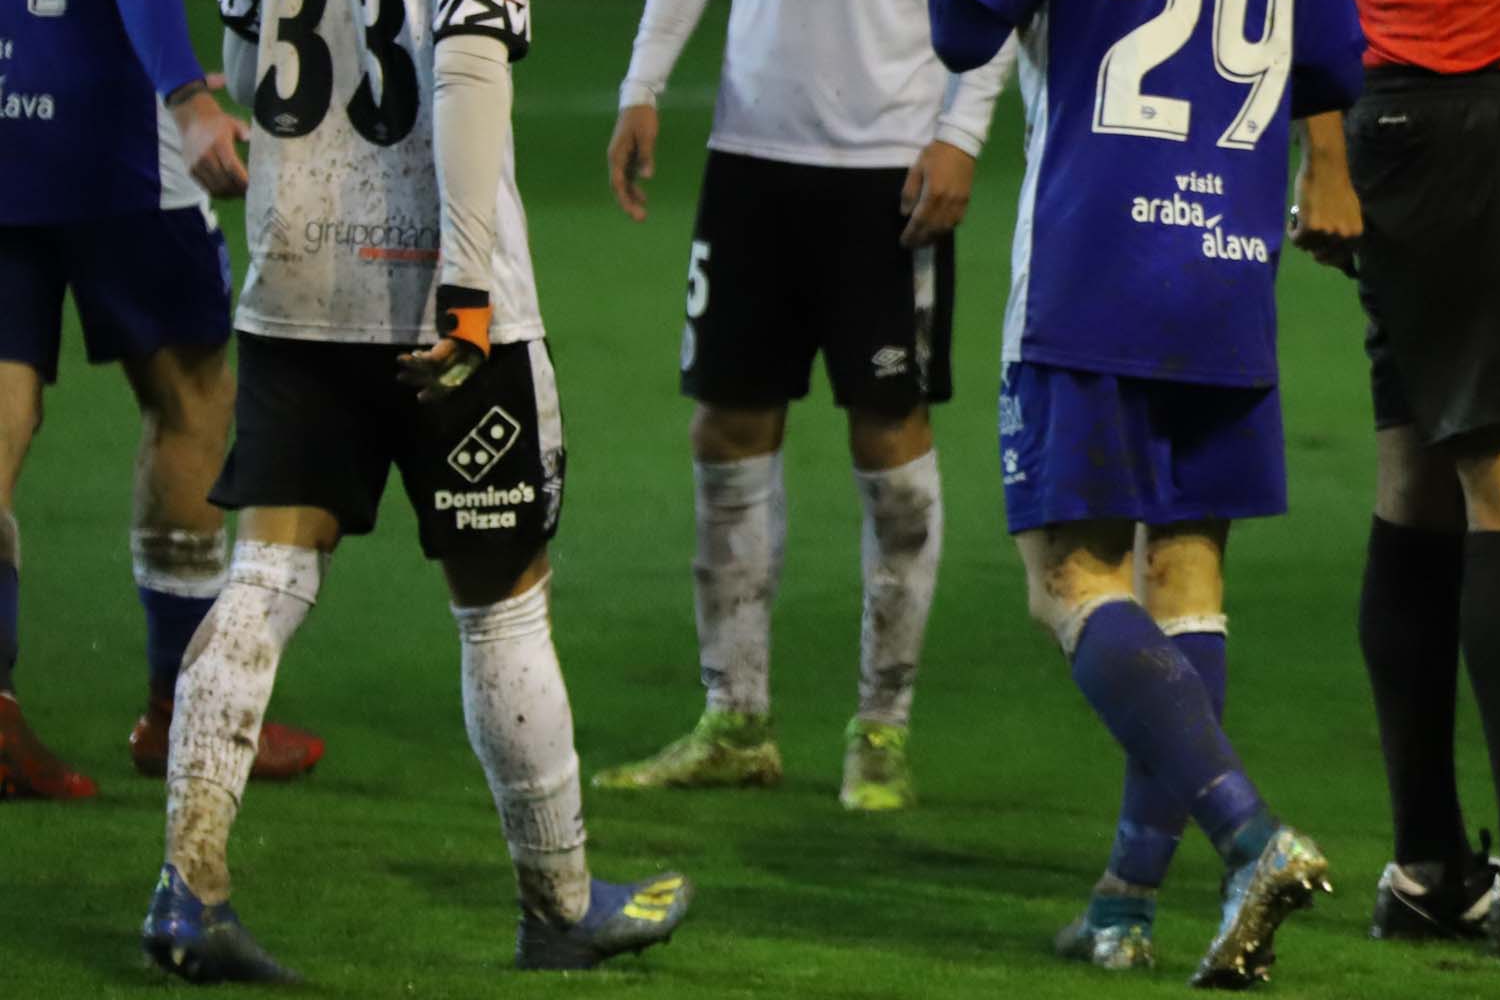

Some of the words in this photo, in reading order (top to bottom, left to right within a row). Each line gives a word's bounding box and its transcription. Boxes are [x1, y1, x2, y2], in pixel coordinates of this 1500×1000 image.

[1175, 171, 1224, 195] visit
[1131, 192, 1205, 228] araba
[434, 481, 536, 511] Domino's
[456, 508, 517, 530] Pizza
